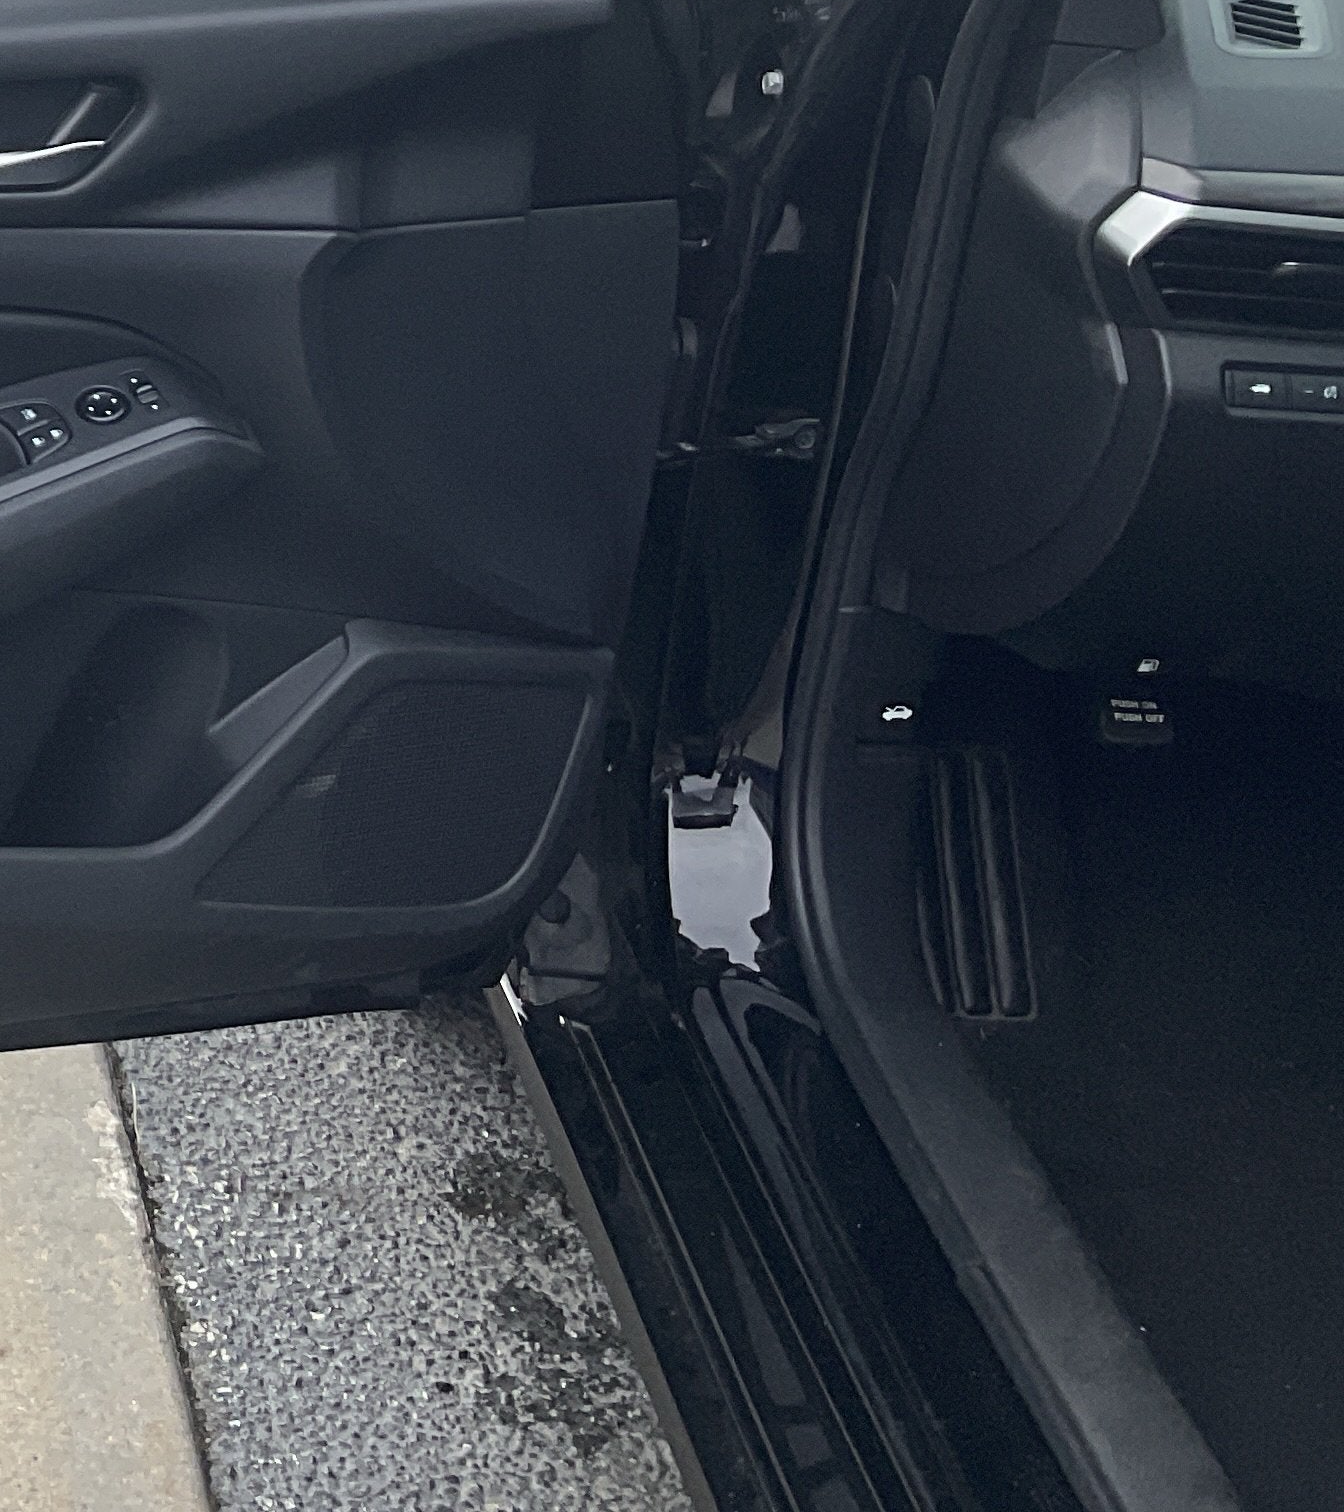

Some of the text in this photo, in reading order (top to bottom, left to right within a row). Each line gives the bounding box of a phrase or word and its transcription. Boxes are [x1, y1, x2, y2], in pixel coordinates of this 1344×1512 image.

[1111, 699, 1139, 708] PUSH
[1114, 712, 1165, 723] PUSH OFF
